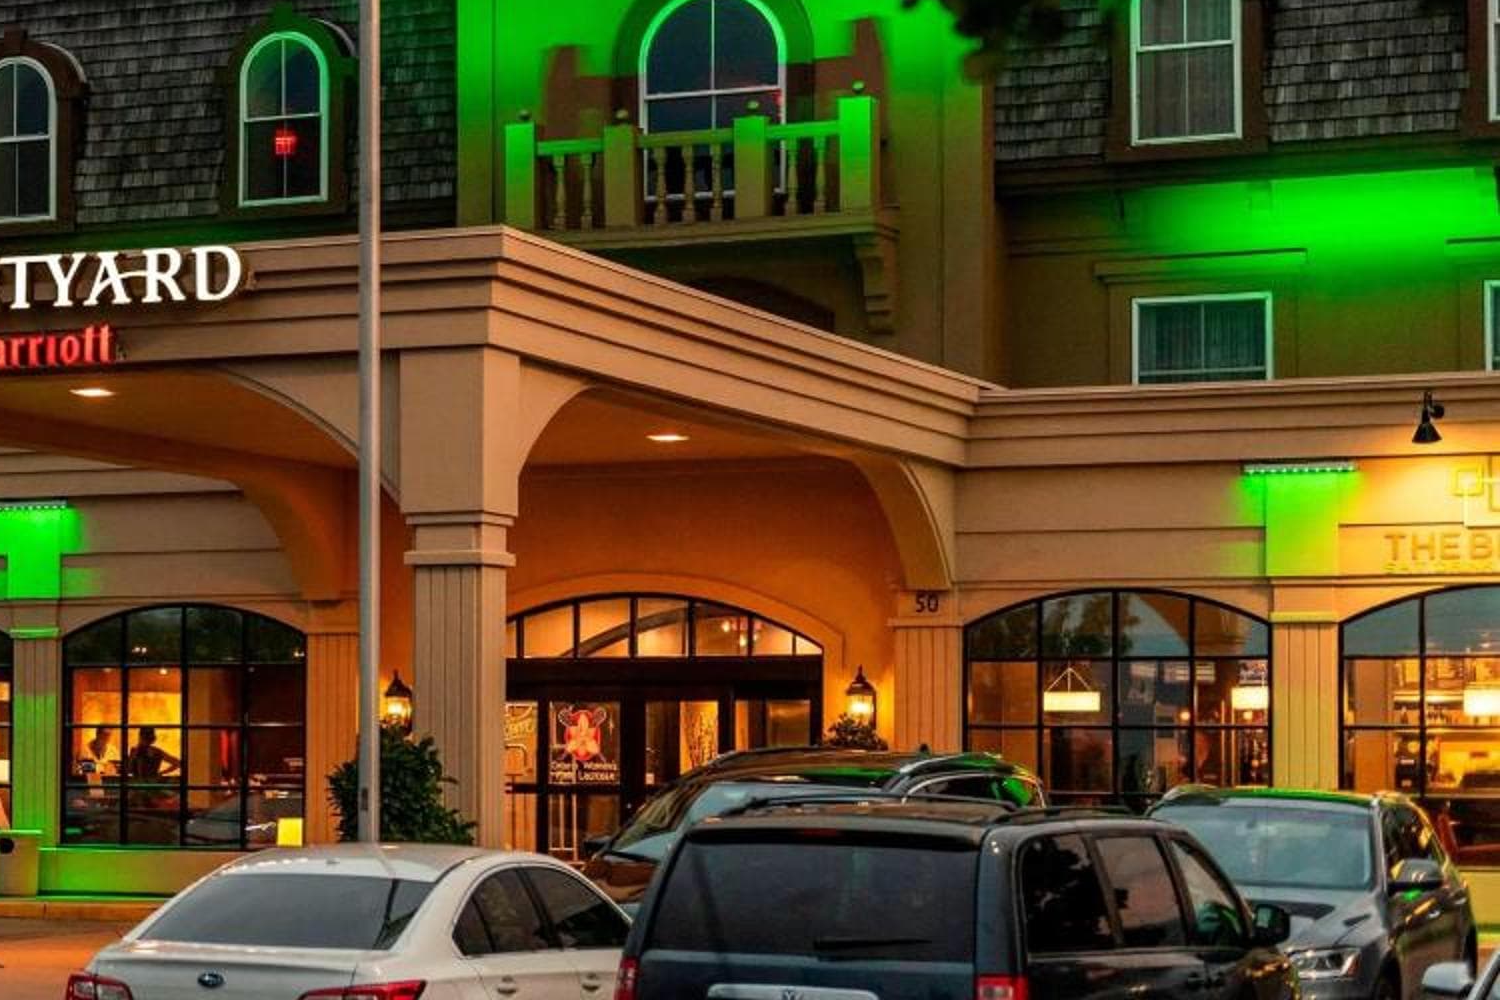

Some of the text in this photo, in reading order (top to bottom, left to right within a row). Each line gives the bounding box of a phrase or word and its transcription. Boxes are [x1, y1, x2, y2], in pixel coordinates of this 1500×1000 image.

[1383, 531, 1500, 561] THE B
[916, 591, 939, 613] 50
